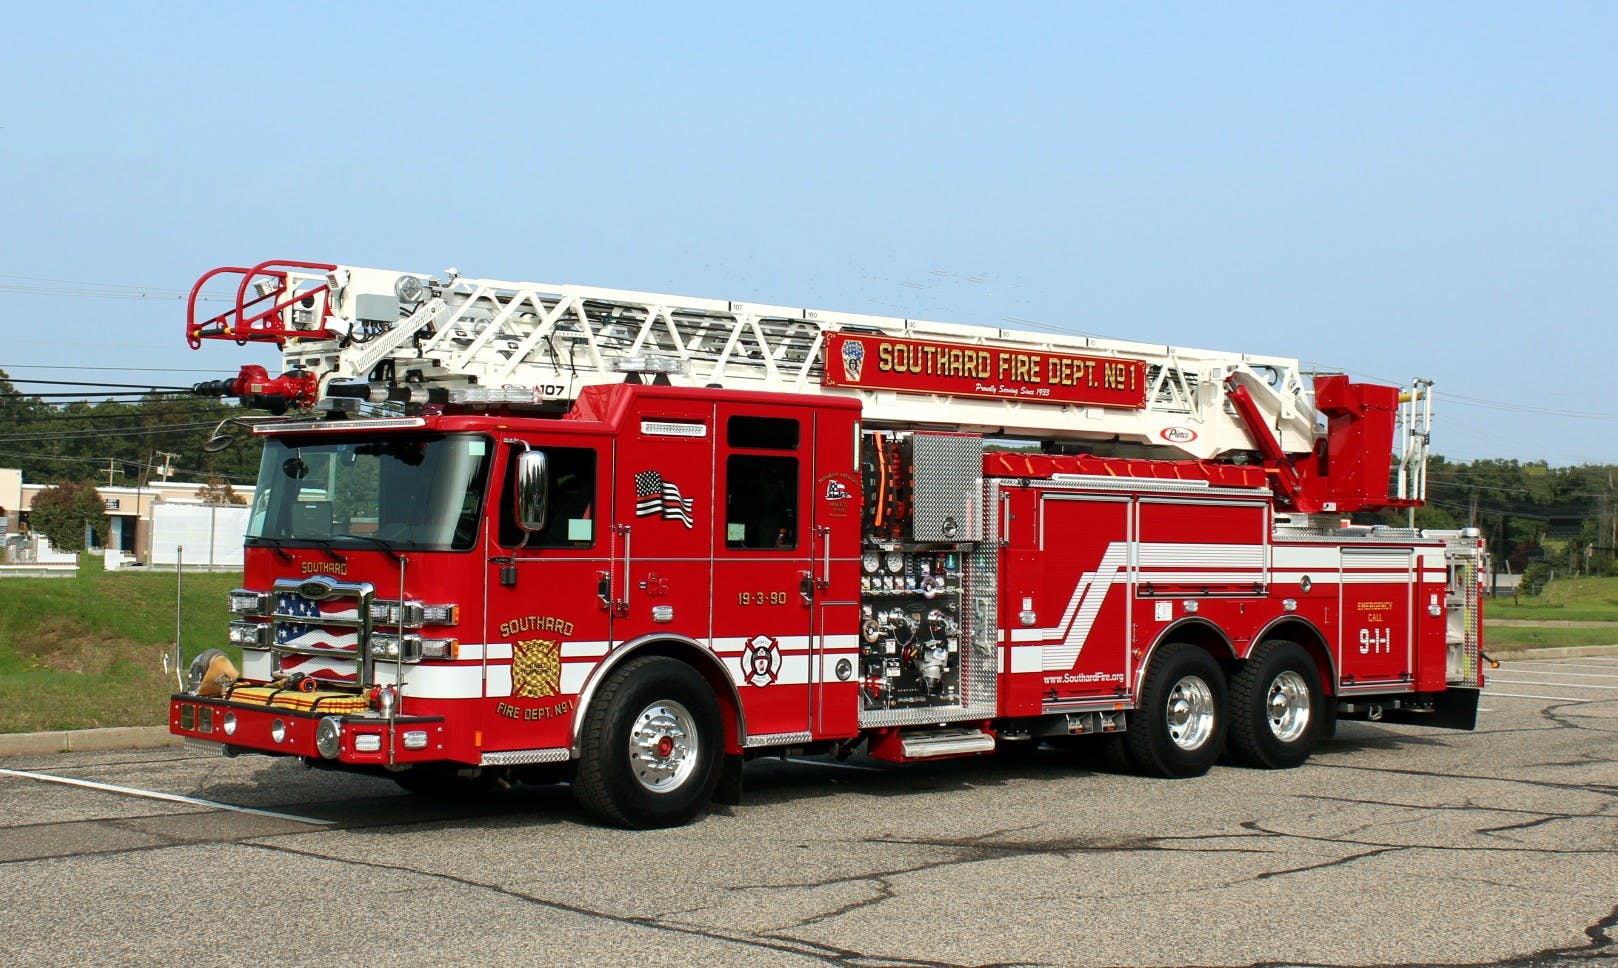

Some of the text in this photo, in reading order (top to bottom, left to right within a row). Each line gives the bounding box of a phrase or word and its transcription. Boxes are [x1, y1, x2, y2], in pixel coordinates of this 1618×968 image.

[879, 342, 992, 380] SOUTHARD
[998, 352, 1042, 384] FIRE
[1047, 356, 1099, 388] DEPT.
[1129, 364, 1137, 391] 1
[540, 384, 565, 396] 107
[975, 383, 1051, 397] Proudly Serving Since 1933
[1168, 428, 1190, 440] Pierce
[301, 561, 348, 576] SOUTHARD
[1357, 601, 1393, 611] EMERGENCY
[1367, 613, 1384, 622] CALL
[500, 615, 574, 638] SOUTHARD
[1359, 628, 1391, 654] 9-1-1
[1043, 671, 1124, 684] www.SouthardFire.org
[497, 702, 520, 719] FIRE
[524, 707, 553, 720] DEPT.
[569, 699, 575, 711] 1
